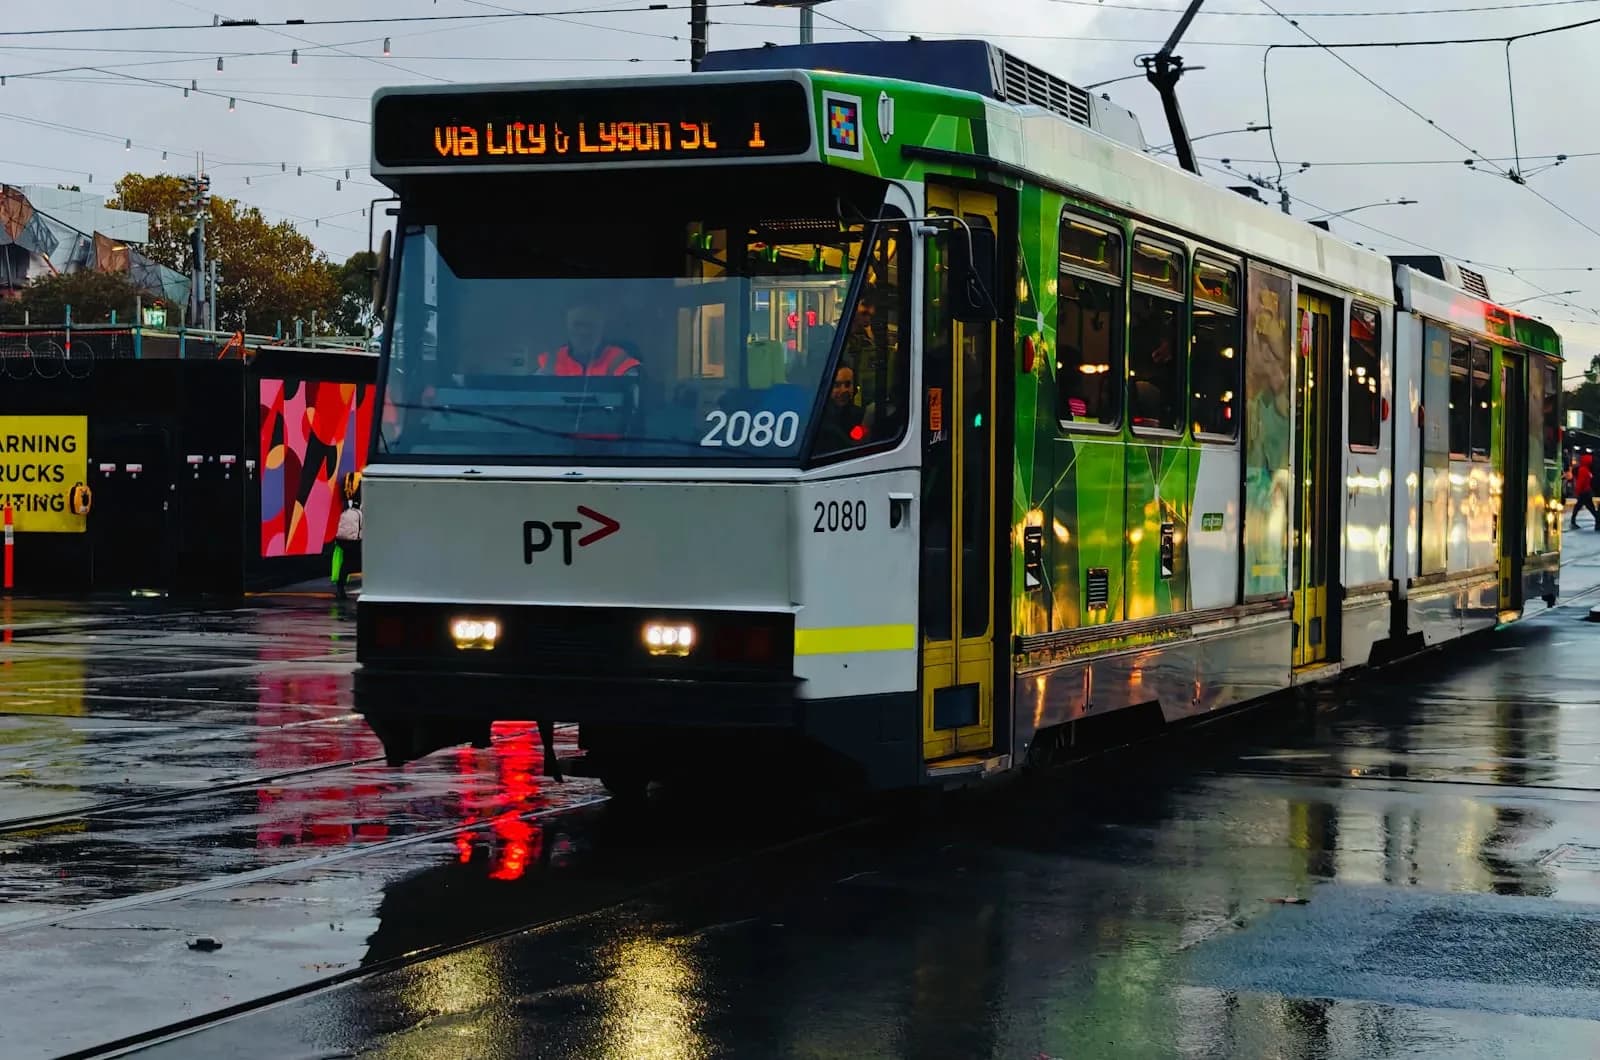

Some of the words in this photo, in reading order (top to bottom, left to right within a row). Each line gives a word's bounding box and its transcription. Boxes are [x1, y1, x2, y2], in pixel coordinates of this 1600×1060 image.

[579, 122, 671, 153] Lygon
[0, 434, 76, 453] RNING
[700, 410, 800, 447] 2080
[0, 493, 65, 512] ITING
[813, 500, 867, 533] 2080
